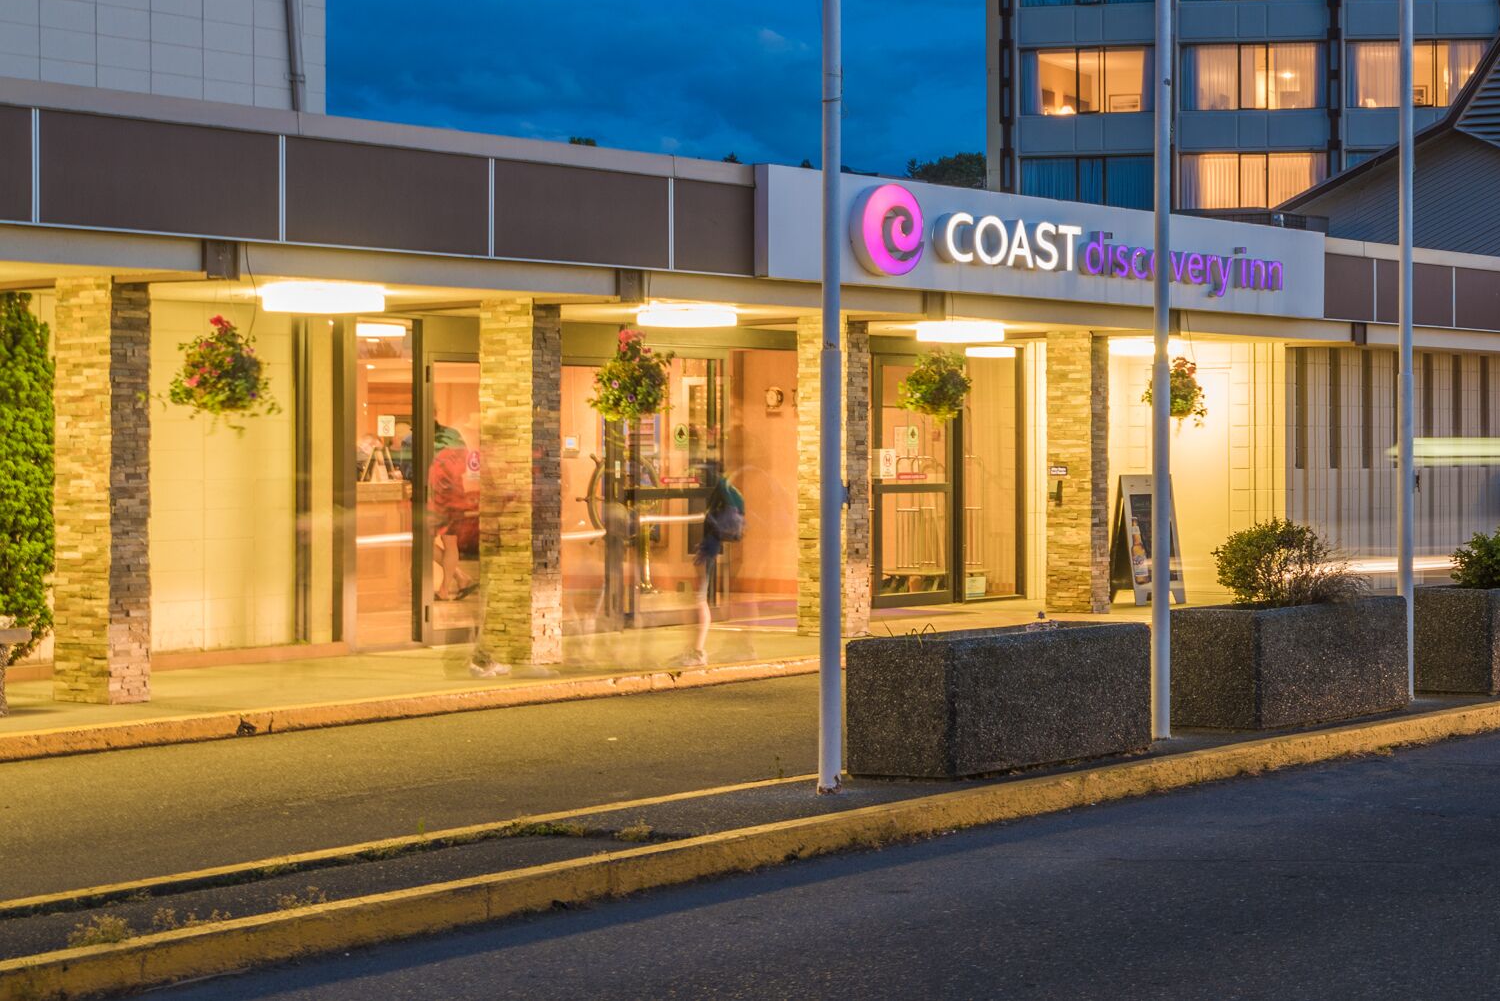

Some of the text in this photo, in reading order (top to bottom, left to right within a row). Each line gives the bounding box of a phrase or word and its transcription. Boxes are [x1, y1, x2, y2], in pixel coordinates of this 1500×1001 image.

[946, 211, 1284, 297] COAST discvery inn
